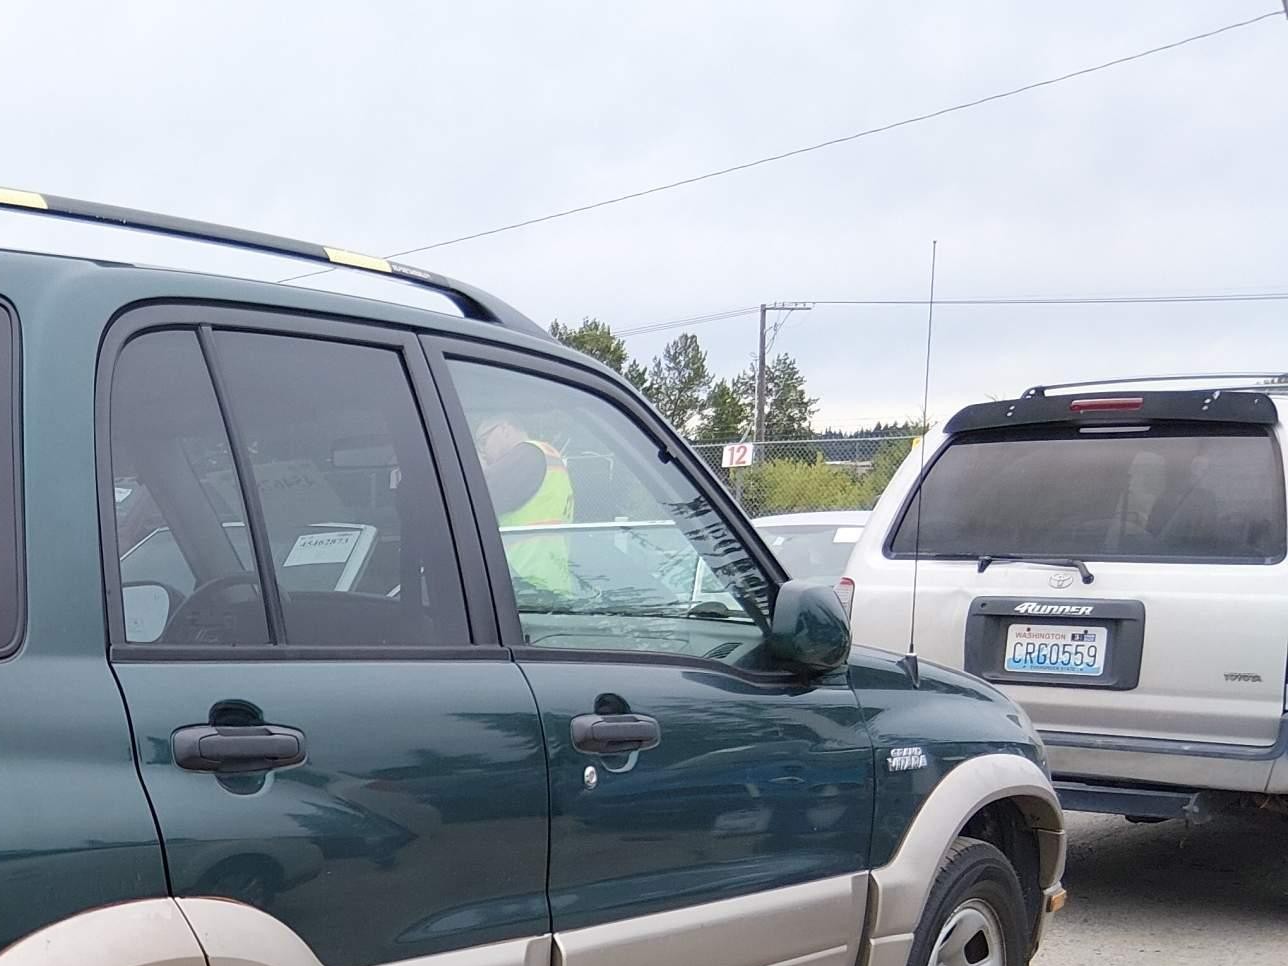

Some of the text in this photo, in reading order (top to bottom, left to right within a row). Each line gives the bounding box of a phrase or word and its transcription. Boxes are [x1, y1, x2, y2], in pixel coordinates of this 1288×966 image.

[727, 445, 748, 466] 12
[1015, 632, 1066, 640] WASHINGTON
[1012, 642, 1098, 667] CRG0559
